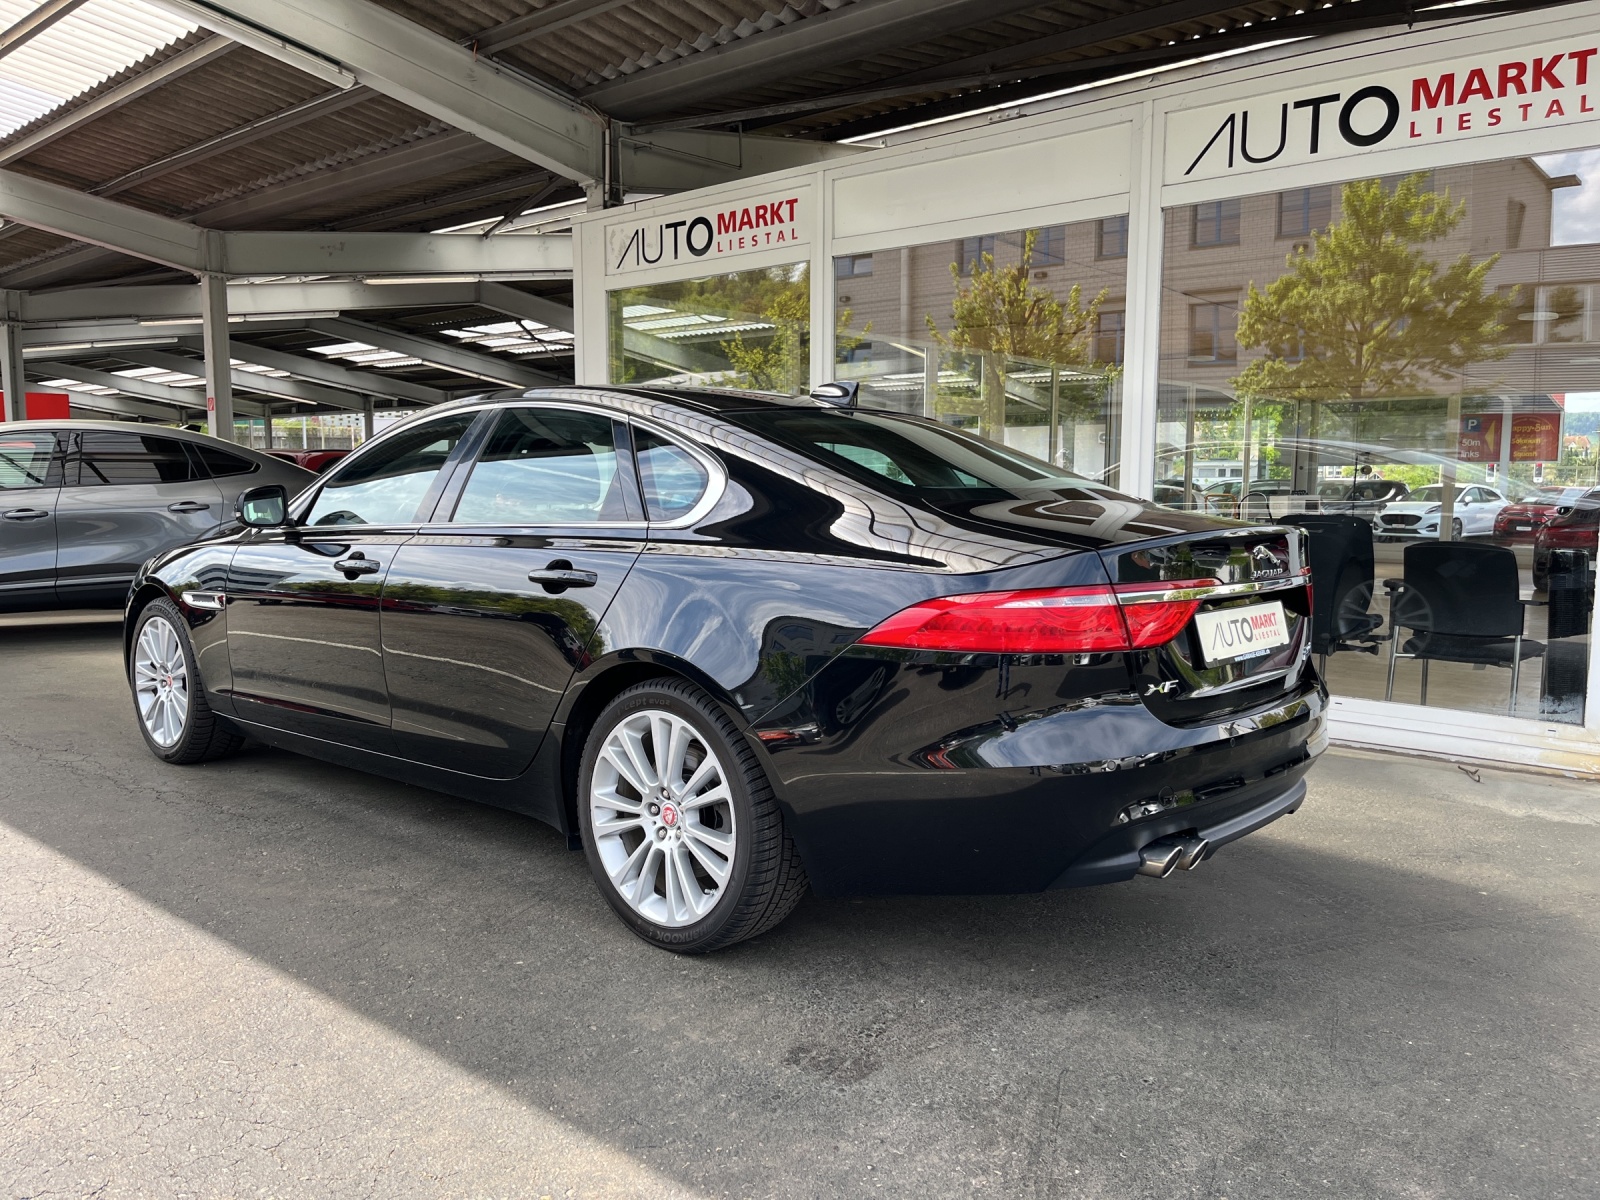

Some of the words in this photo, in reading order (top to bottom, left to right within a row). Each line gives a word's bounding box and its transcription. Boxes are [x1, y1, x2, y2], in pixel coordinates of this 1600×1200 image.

[1183, 85, 1400, 175] AUTO
[1411, 48, 1598, 112] MARKT
[1409, 94, 1595, 138] LIESTAL
[616, 216, 714, 269] AUTO
[717, 198, 799, 235] MARKT
[717, 228, 799, 252] LIESTAL
[1468, 419, 1478, 430] P
[1511, 423, 1552, 432] appy-Sun
[1461, 439, 1481, 447] 50m
[1460, 450, 1480, 458] links
[1212, 617, 1254, 650] AUTO
[1251, 612, 1278, 630] MARKT
[1254, 630, 1281, 641] LIESTAL
[1143, 679, 1179, 696] XF
